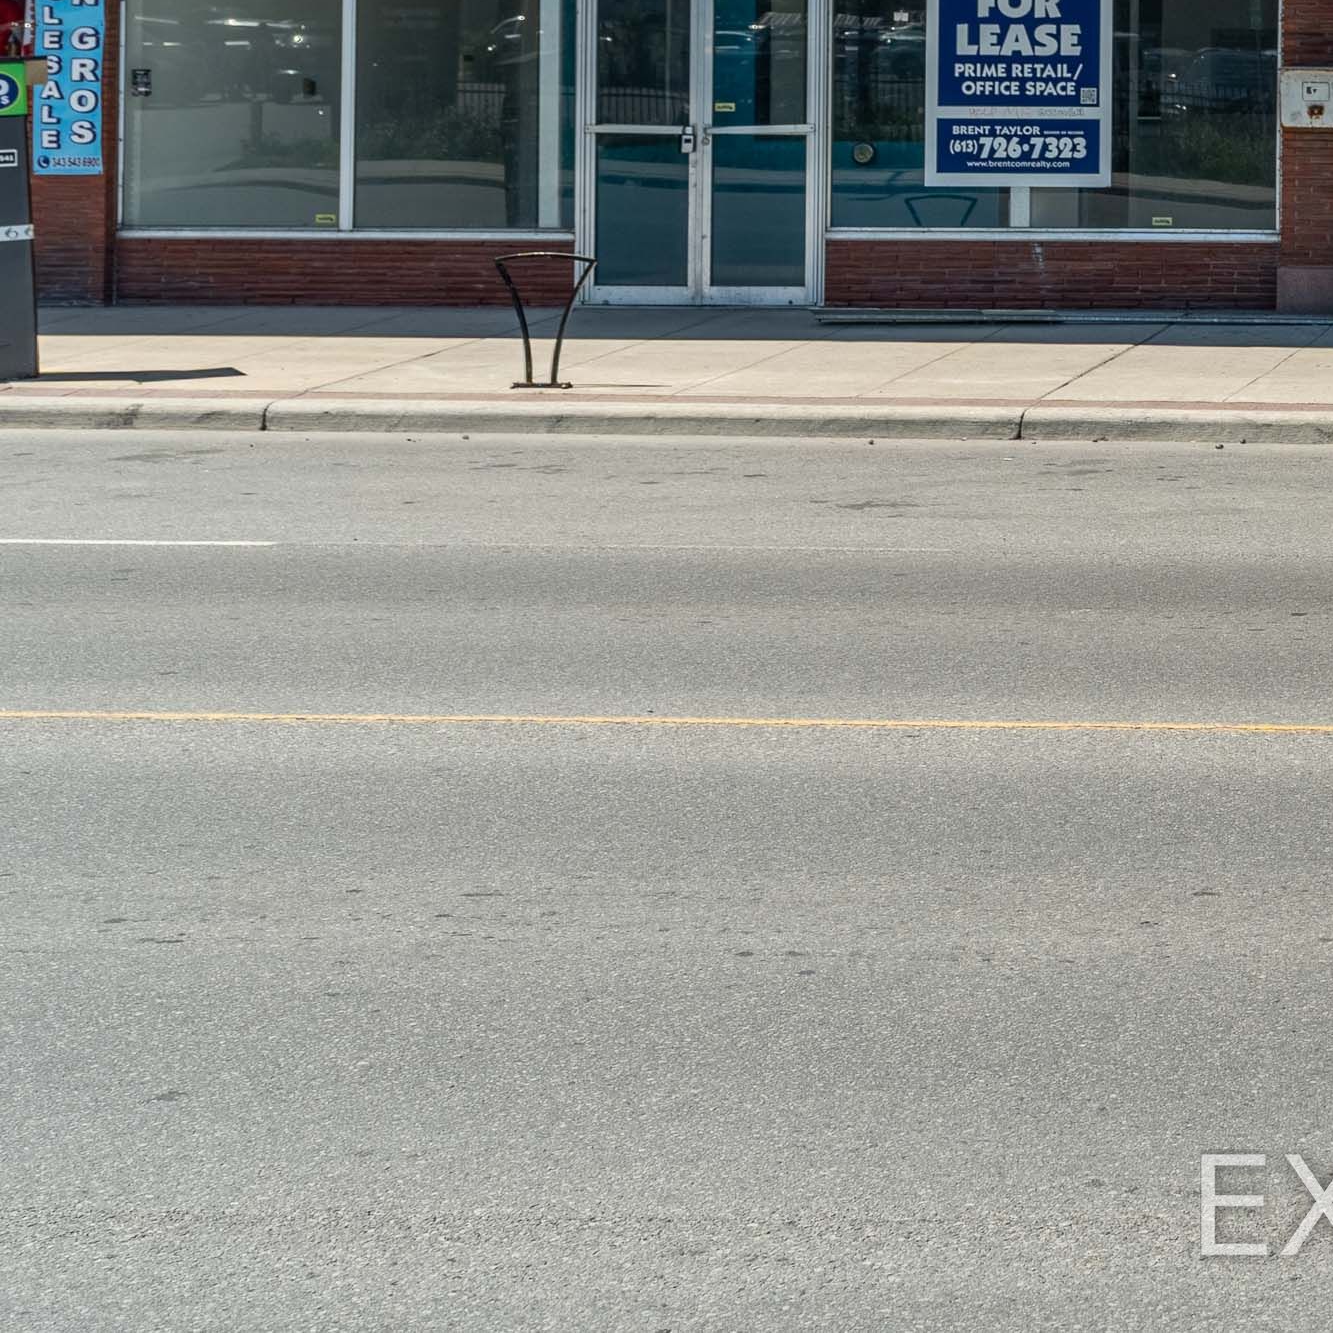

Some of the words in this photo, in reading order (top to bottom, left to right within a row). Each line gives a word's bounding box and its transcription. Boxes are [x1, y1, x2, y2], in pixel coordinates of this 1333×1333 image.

[956, 24, 1082, 57] LEASE
[954, 63, 1007, 78] PRIME
[69, 27, 100, 146] GROS
[961, 81, 1020, 96] OFFICE
[1025, 81, 1076, 96] SPACE
[952, 125, 991, 135] BRENT
[994, 125, 1040, 135] TAYLOR
[949, 139, 978, 155] (613)
[966, 160, 1070, 169] www.brentcomrealty.com
